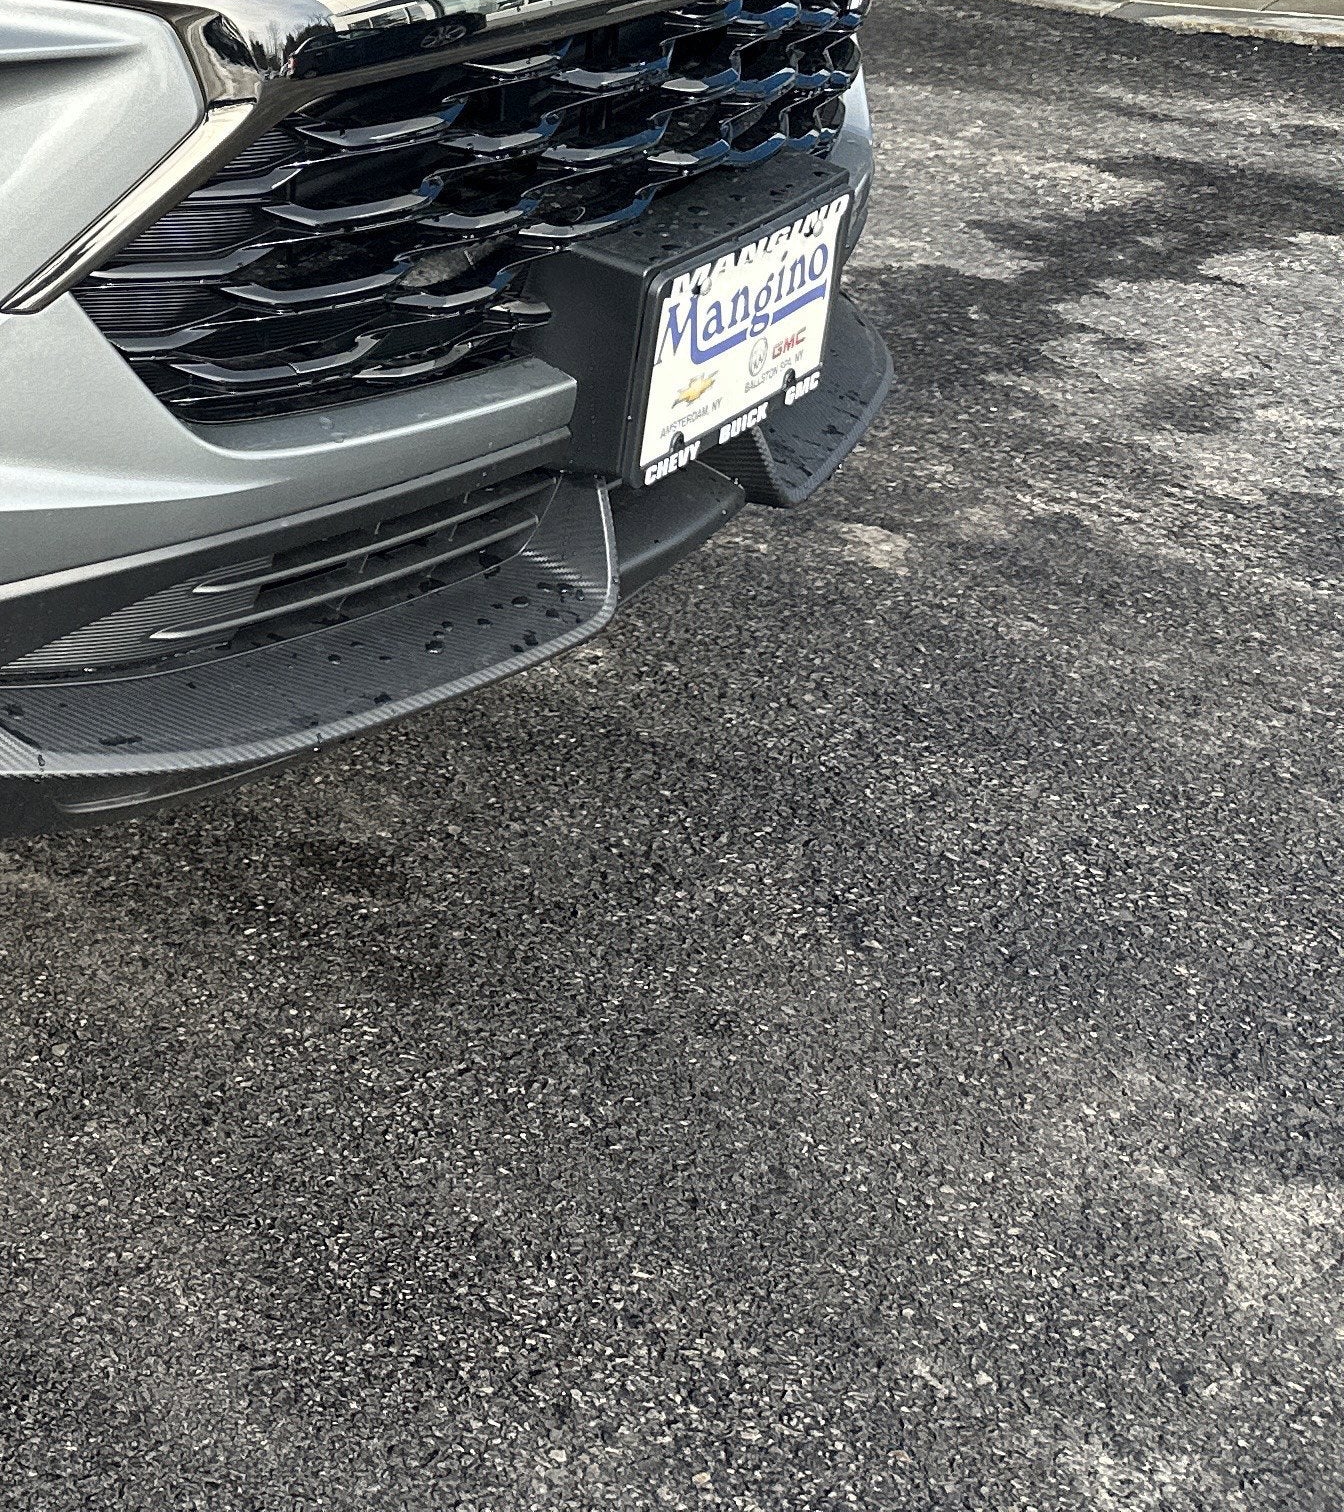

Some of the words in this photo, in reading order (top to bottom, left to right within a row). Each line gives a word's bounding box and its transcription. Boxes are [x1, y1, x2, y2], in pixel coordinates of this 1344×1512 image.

[654, 242, 829, 365] Mangino
[771, 326, 808, 360] GMC
[644, 439, 701, 486] CHEVY
[717, 401, 770, 445] BUICK
[784, 370, 821, 406] GMC
